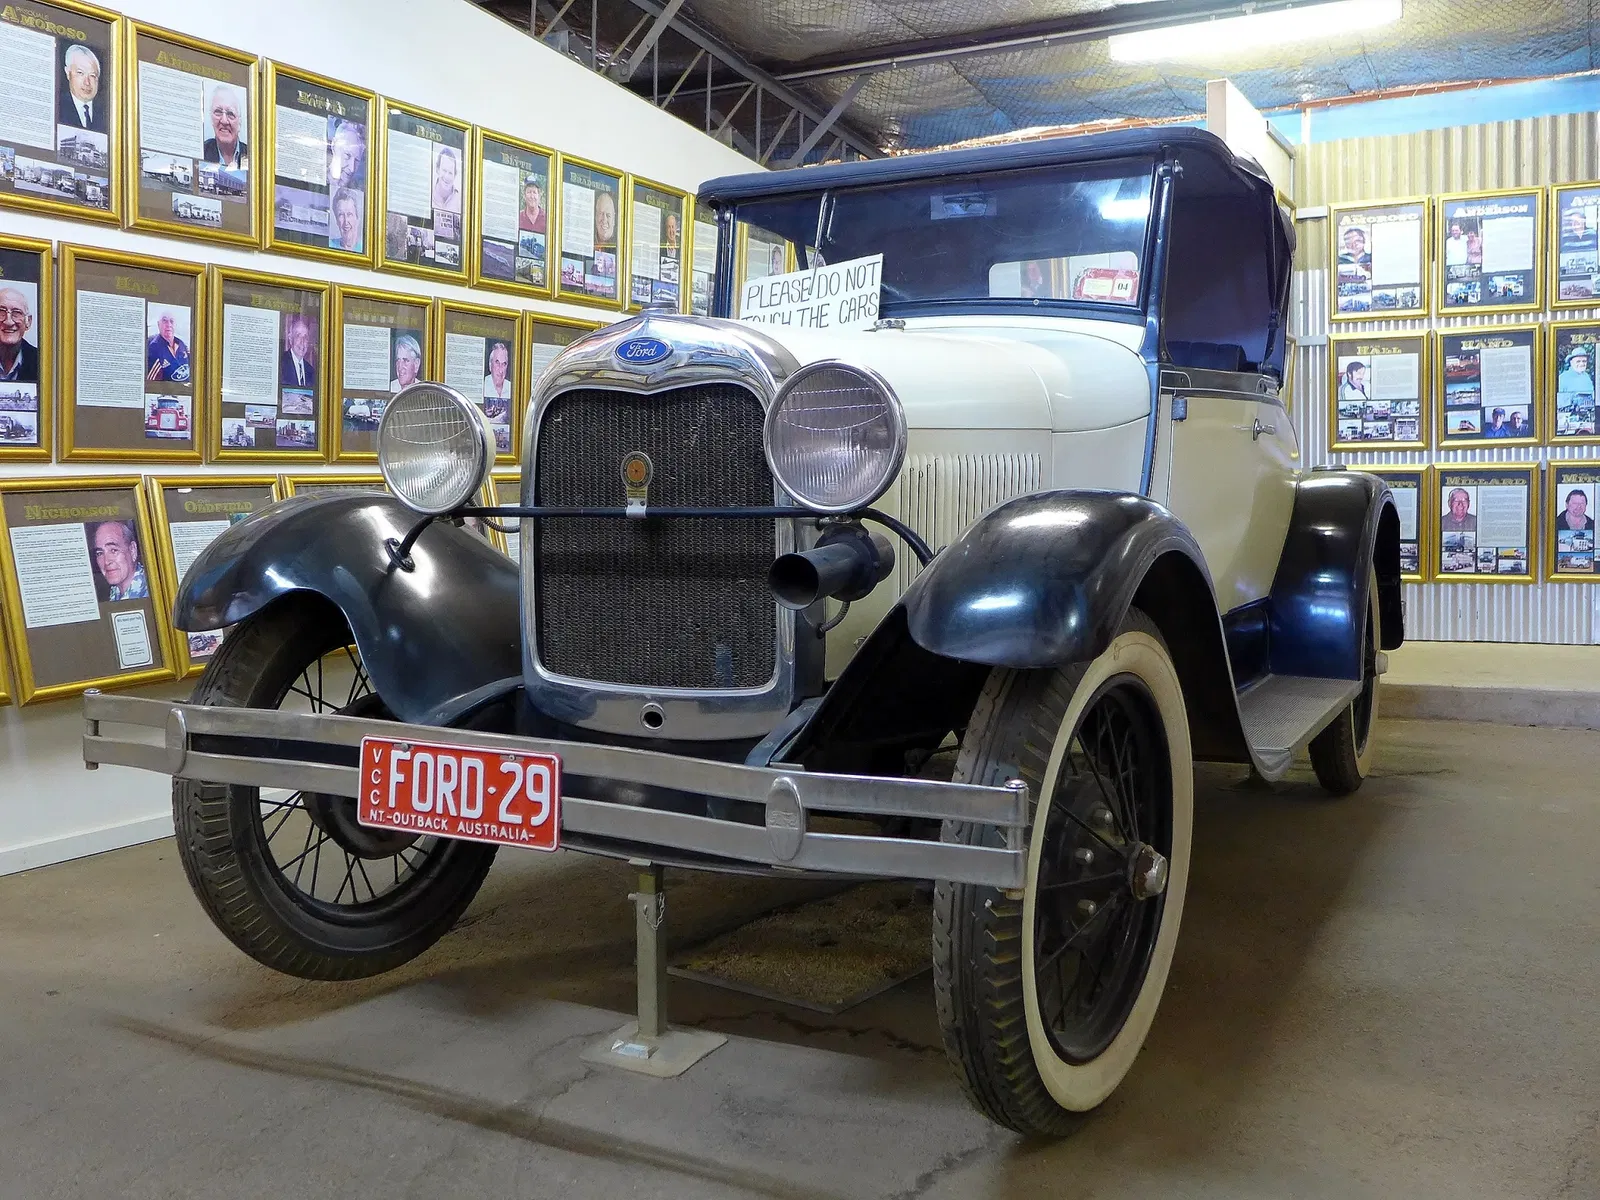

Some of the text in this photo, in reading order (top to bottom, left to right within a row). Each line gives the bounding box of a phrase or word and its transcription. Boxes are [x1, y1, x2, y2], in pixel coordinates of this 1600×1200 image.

[1, 5, 87, 41] AMOROSO
[415, 124, 443, 142] BIRD
[746, 261, 881, 310] PLEASE DO NOT
[796, 303, 830, 329] THE
[838, 291, 879, 325] CARS
[626, 341, 658, 358] Ford
[1356, 345, 1402, 356] HALL
[1460, 339, 1514, 351] HAND
[1445, 476, 1527, 486] MILLARD
[24, 505, 120, 521] NICHOLSON
[184, 500, 254, 514] OLDFIELD
